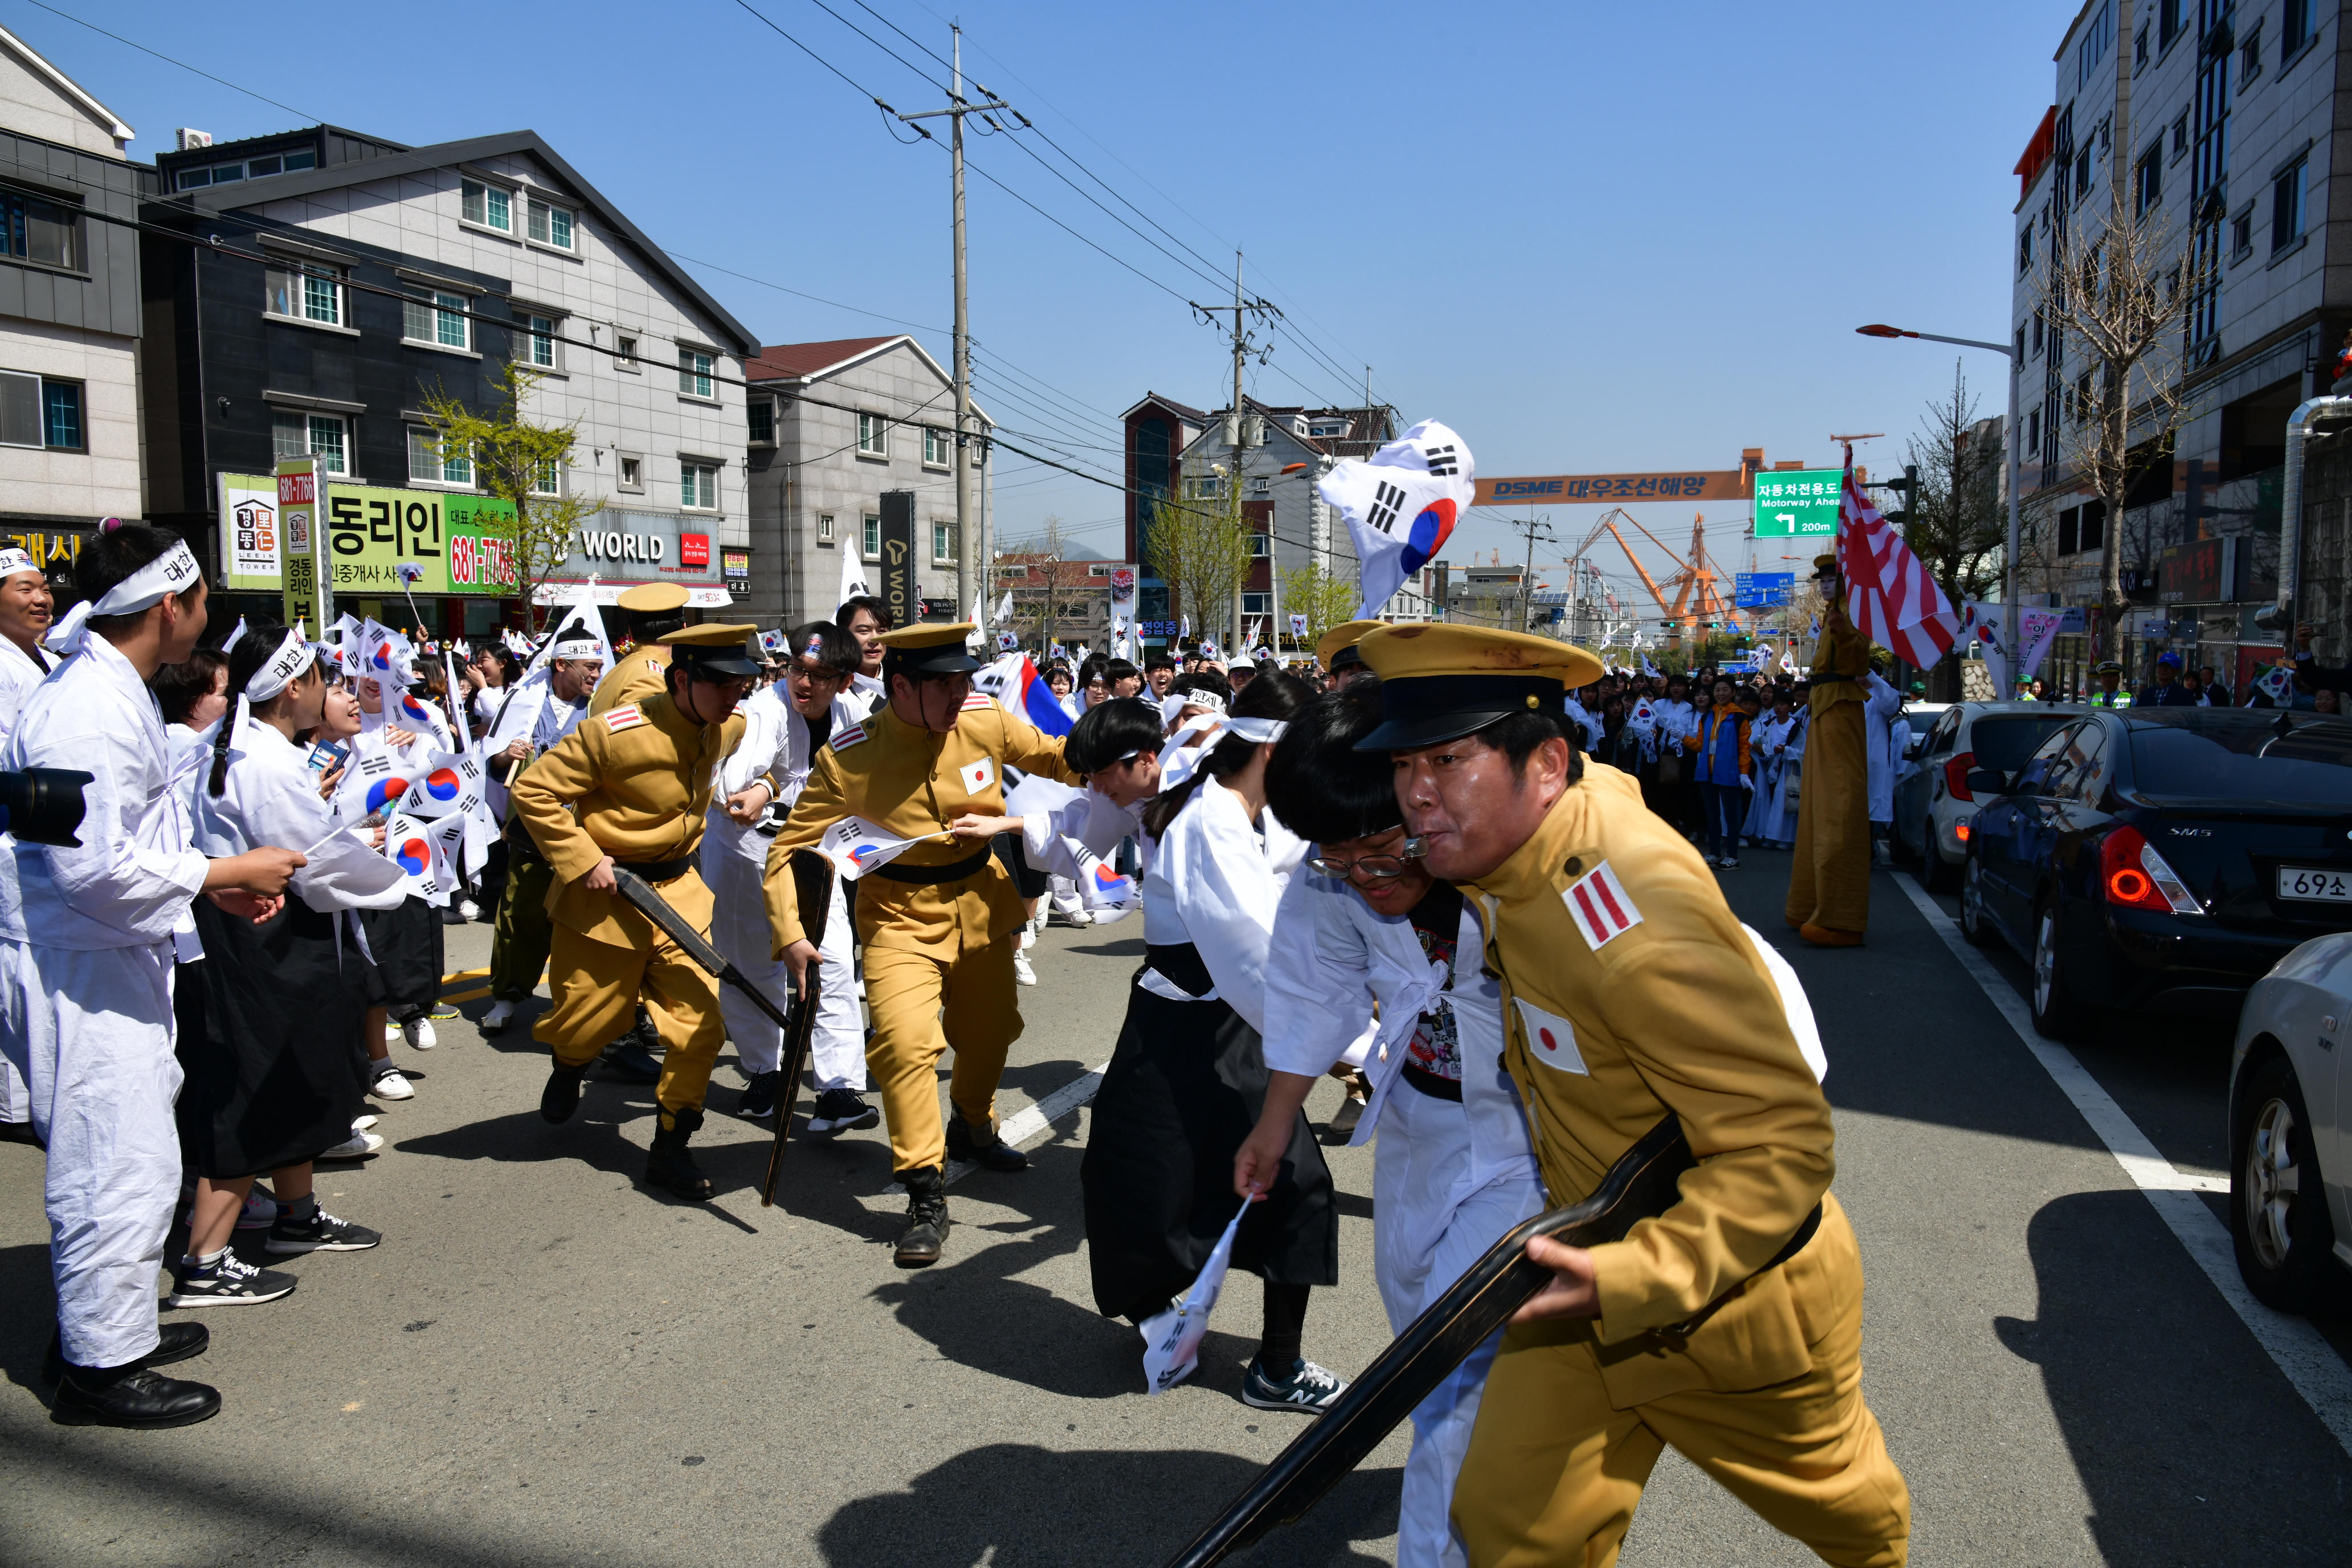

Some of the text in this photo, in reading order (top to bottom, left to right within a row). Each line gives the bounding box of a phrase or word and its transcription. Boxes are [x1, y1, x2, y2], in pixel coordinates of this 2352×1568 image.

[280, 476, 313, 502] 681-7766
[1494, 477, 1707, 498] DSME 대우조선해양
[1758, 483, 1841, 497] 자동차전용도
[1762, 499, 1810, 508] Motorway
[329, 497, 440, 557] 동리인
[451, 509, 469, 525] 대표
[0, 533, 80, 570] 개사
[582, 530, 664, 560] WORLD
[164, 550, 193, 581] 대한
[289, 558, 312, 577] 경동
[450, 535, 516, 585] 681-7766
[290, 577, 312, 595] 리인
[890, 570, 904, 629] WORL
[568, 644, 589, 655] 대한
[273, 649, 304, 678] 대한
[1194, 692, 1216, 708] 만세
[2167, 828, 2213, 837] SM5
[2294, 873, 2346, 897] 69소
